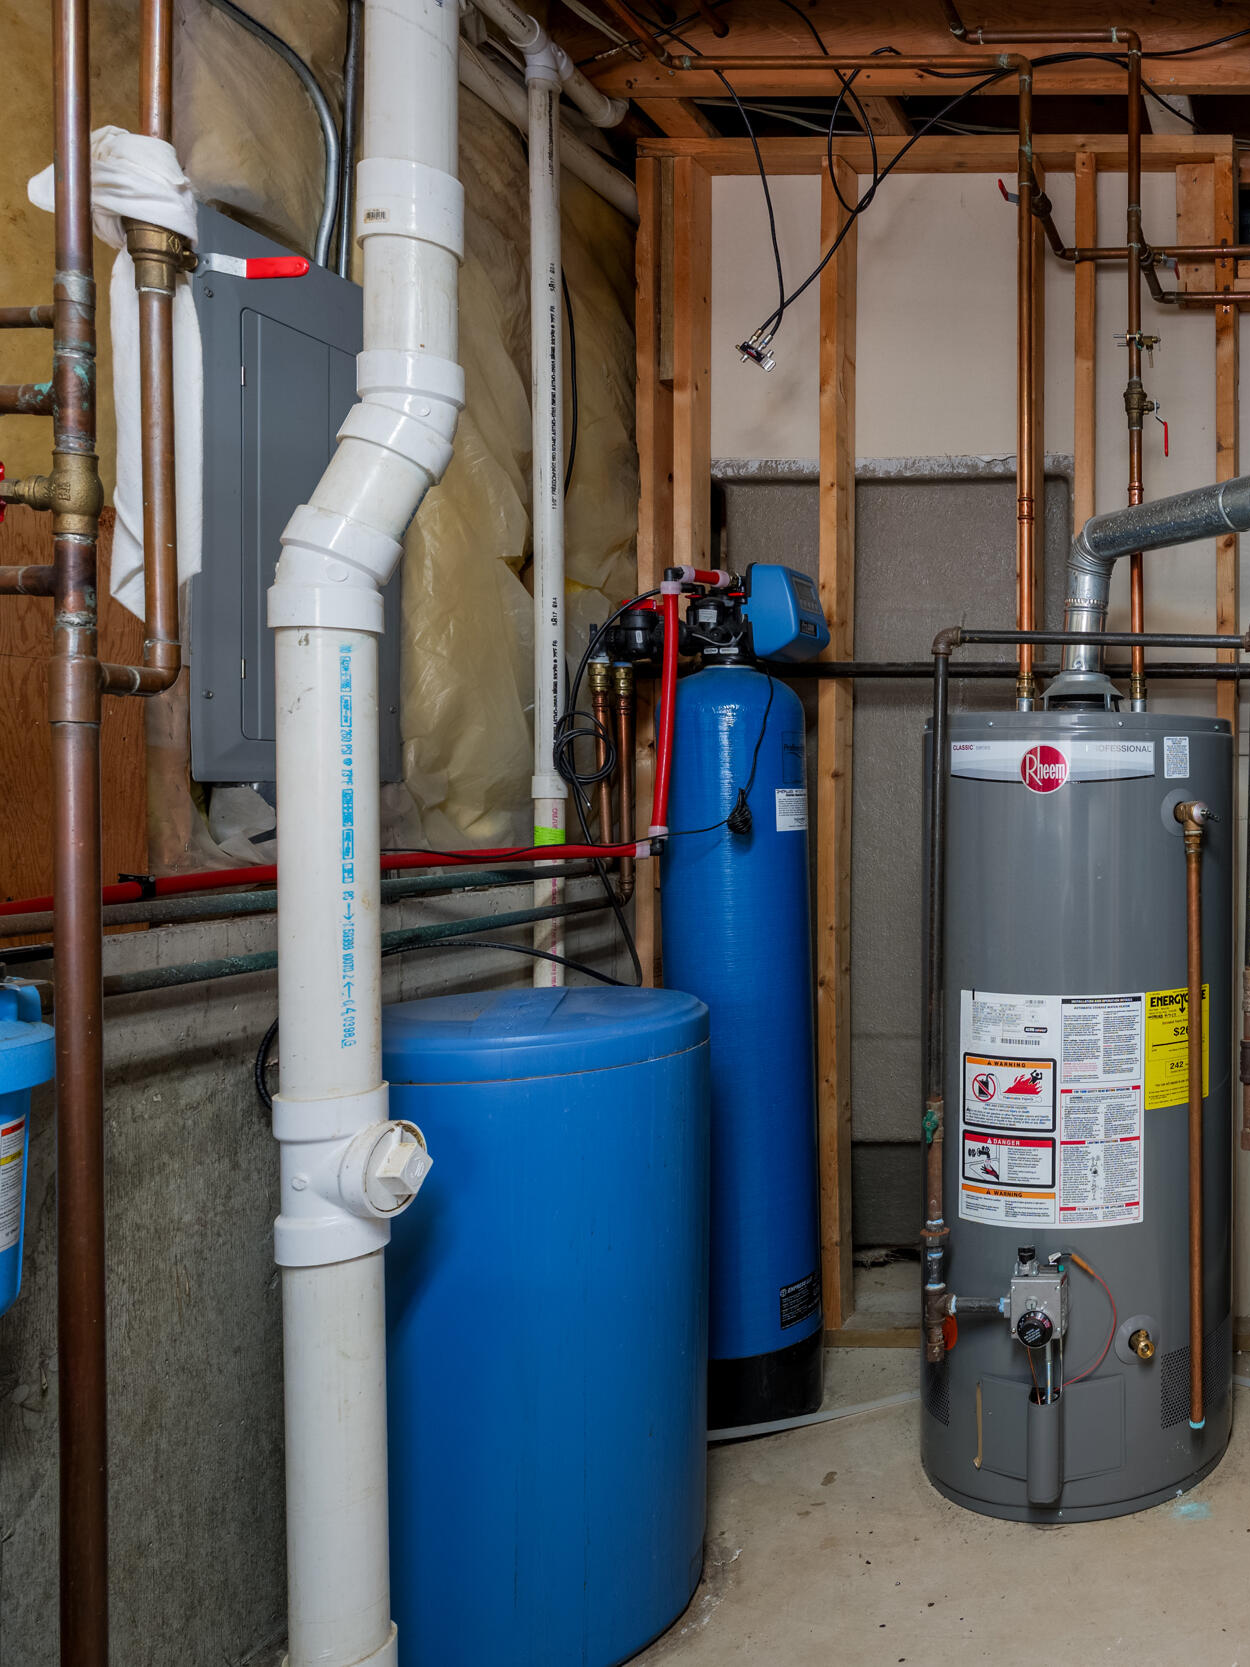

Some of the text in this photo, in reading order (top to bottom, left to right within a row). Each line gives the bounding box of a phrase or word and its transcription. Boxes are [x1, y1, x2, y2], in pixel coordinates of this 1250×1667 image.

[340, 728, 352, 743] 260
[341, 744, 352, 755] PSI
[1025, 745, 1067, 786] Rheem
[1170, 1061, 1184, 1070] 242
[993, 1138, 1020, 1146] DANGER
[994, 1190, 1023, 1198] WARNING
